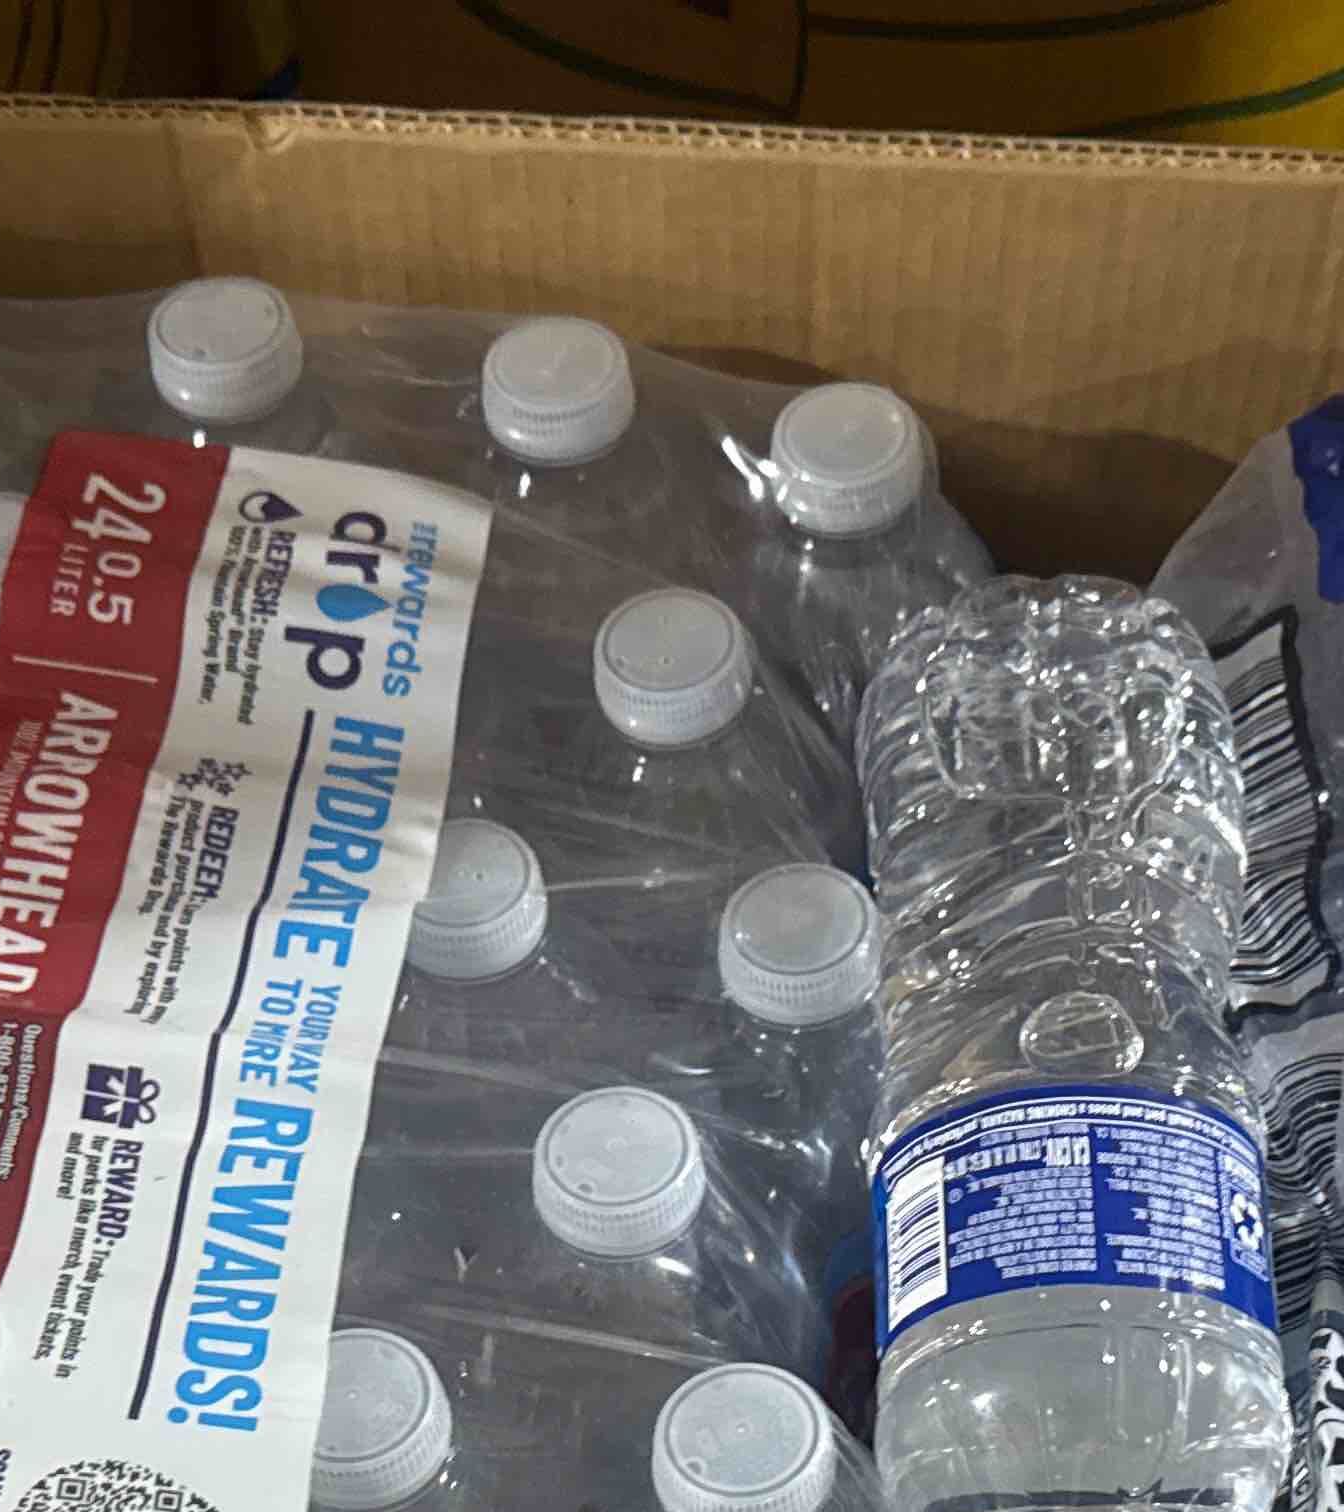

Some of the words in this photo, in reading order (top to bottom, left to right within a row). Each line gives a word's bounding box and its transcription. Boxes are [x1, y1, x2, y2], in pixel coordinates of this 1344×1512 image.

[68, 472, 168, 548] 24
[45, 542, 90, 617] LITER
[81, 548, 144, 626] 0.5
[374, 520, 443, 700] rewards
[268, 715, 408, 969] HYDRATE
[258, 974, 304, 1018] TO
[295, 980, 342, 1043] YOUR
[73, 1197, 98, 1224] like
[92, 1137, 145, 1248] REWARD:
[163, 1098, 315, 1434] REWARDS!
[55, 1316, 89, 1361] points
